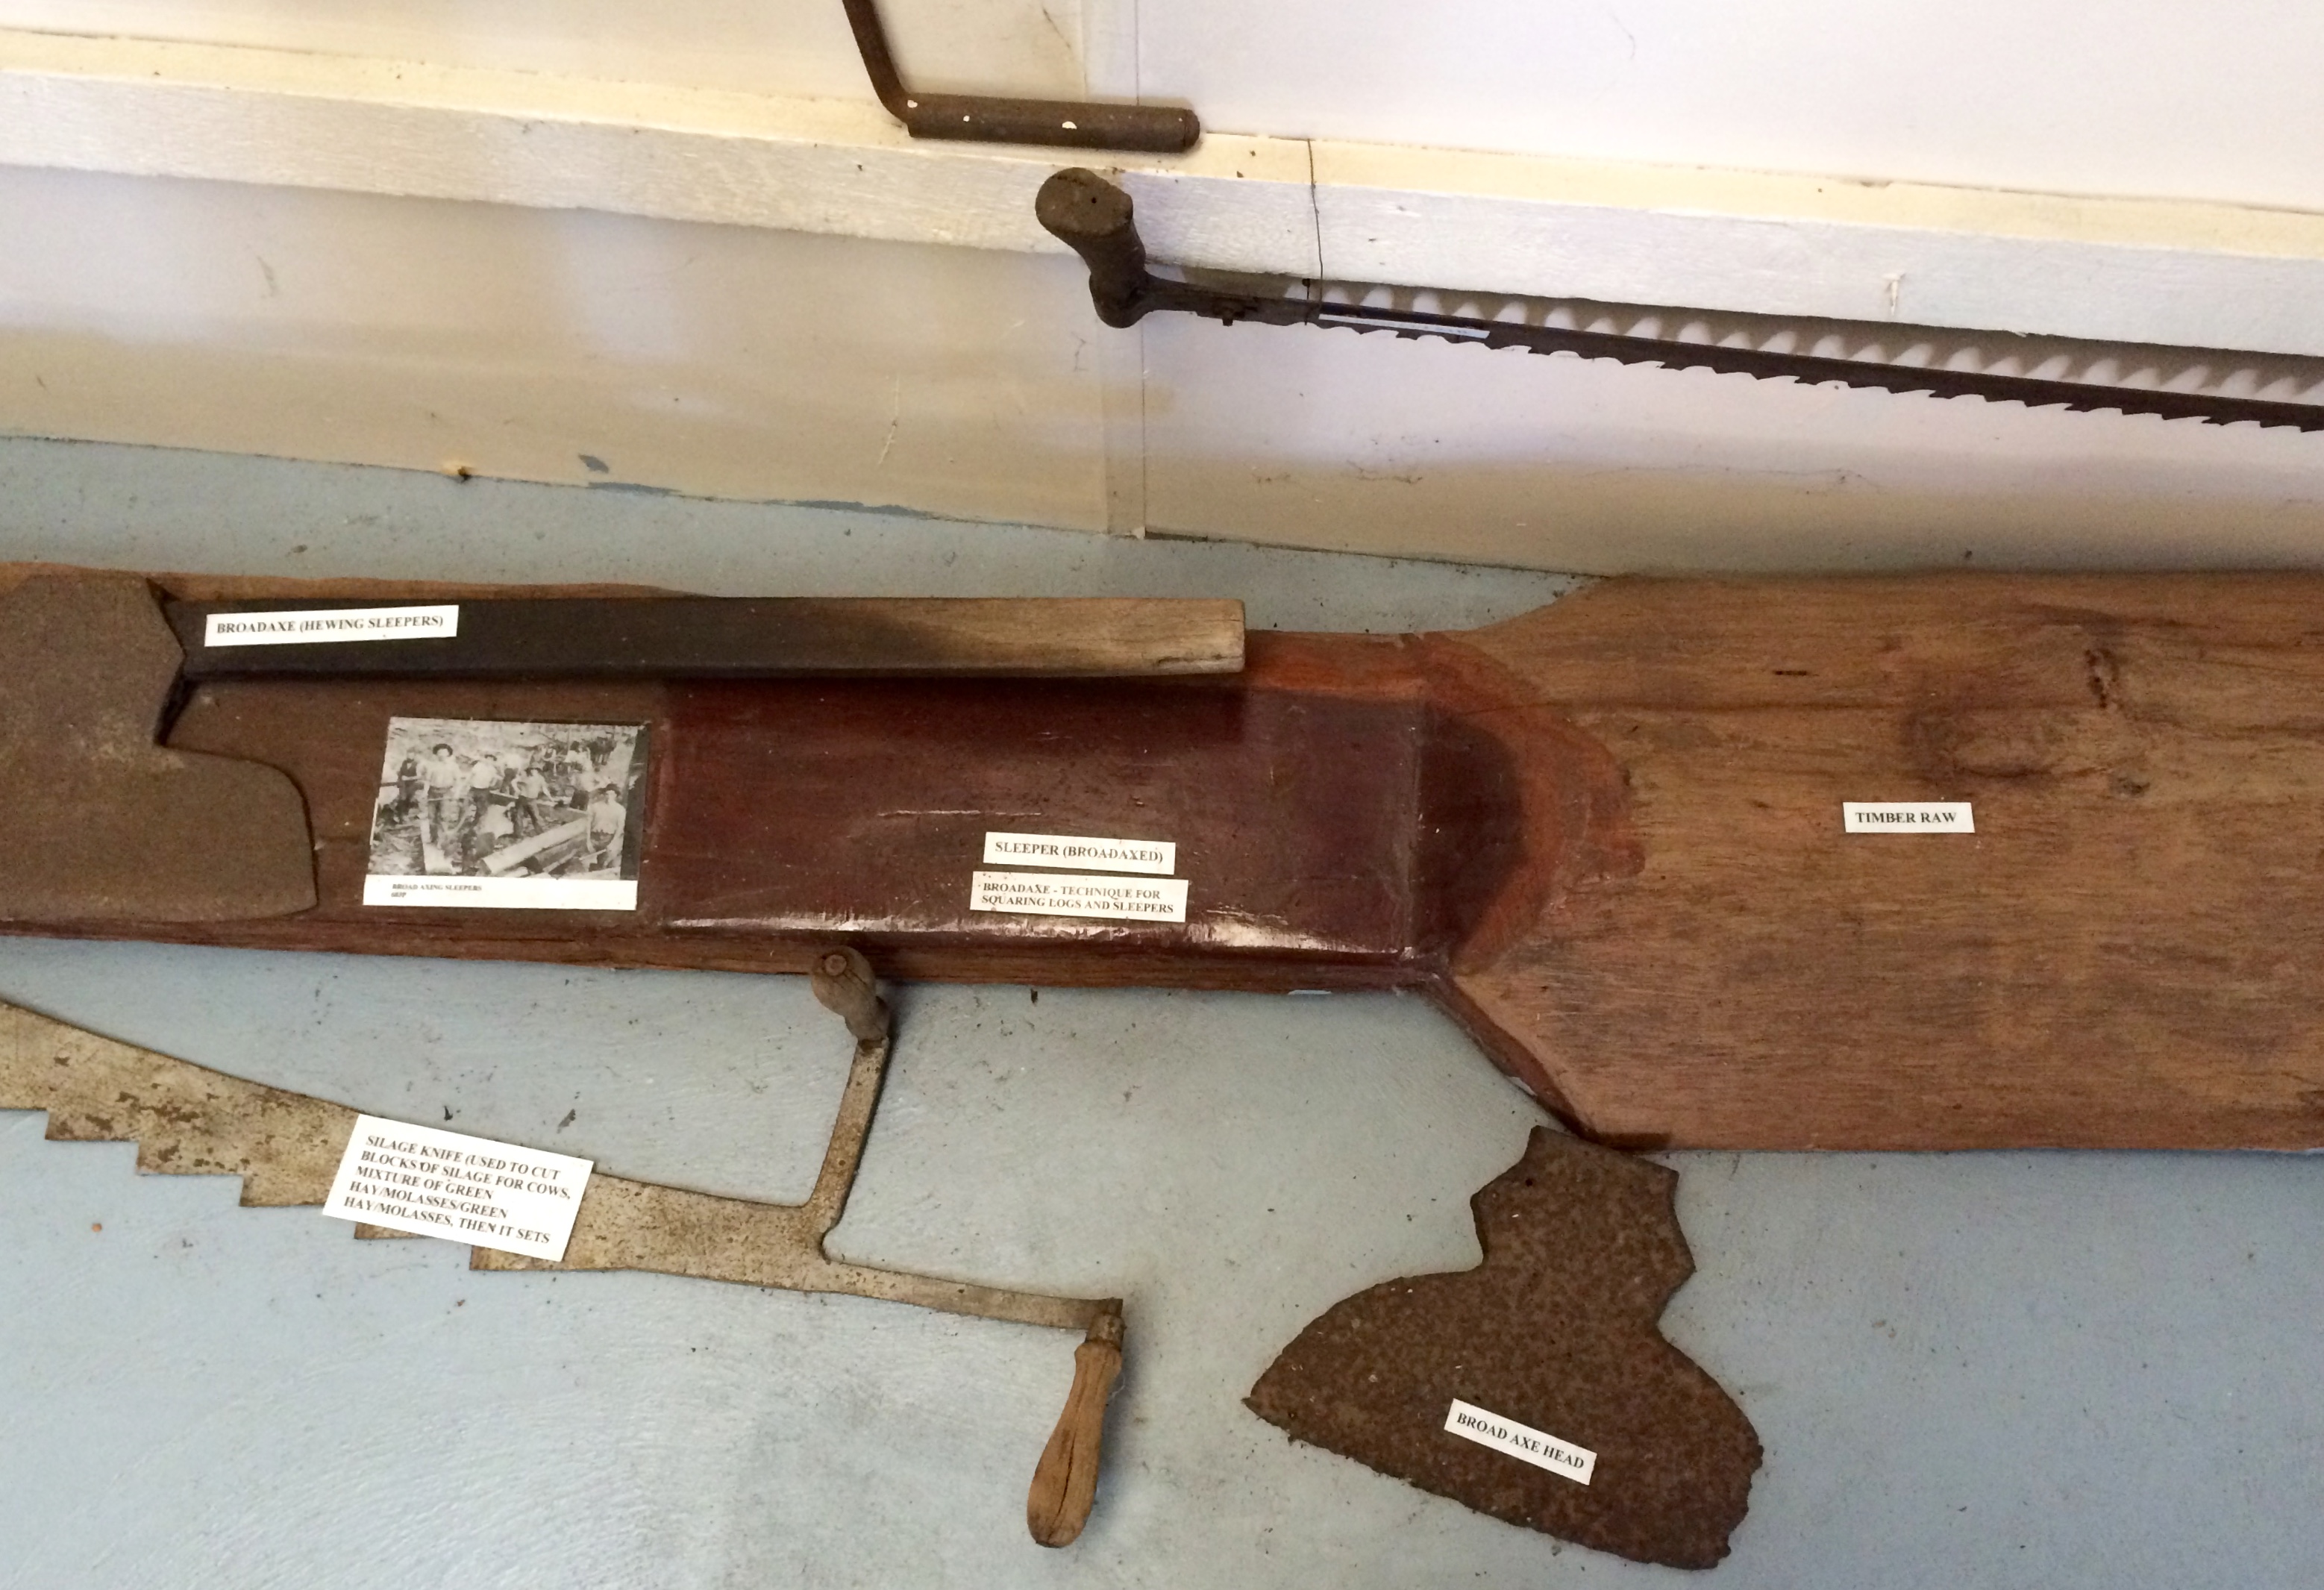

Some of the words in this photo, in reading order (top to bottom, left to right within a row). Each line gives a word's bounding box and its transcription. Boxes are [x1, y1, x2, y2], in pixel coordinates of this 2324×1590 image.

[216, 620, 296, 634] BROADAXE
[299, 619, 364, 633] (HEWING
[368, 616, 444, 629] SLEEPERS)
[1855, 812, 1917, 823] TIMBER
[1921, 812, 1957, 823] RAW
[995, 842, 1059, 856] SLEEPER
[1063, 845, 1164, 864] (BROADAXED)
[981, 895, 1045, 907] SQUARING
[1049, 898, 1082, 909] LOGS
[1084, 900, 1110, 910] AND
[1112, 902, 1174, 913] SLEEPERS
[983, 883, 1050, 895] BROADAXE
[1060, 886, 1133, 900] TECHNIQUE
[1136, 889, 1160, 899] FOR
[360, 1150, 417, 1171] BLOCKS
[420, 1162, 440, 1174] OF
[442, 1165, 492, 1184] SILAGE
[495, 1177, 523, 1190] FOR
[527, 1182, 571, 1201] COWS,
[366, 1135, 418, 1154] SILAGE
[421, 1146, 464, 1163] KNIFE
[465, 1154, 507, 1171] (USED
[510, 1162, 529, 1174] TO
[531, 1166, 561, 1180] CUT
[349, 1180, 509, 1219] HAY/MOLASSES/GREEN
[355, 1165, 421, 1187] MIXTURE
[424, 1179, 442, 1192] OF
[445, 1183, 494, 1201] GREEN
[343, 1196, 454, 1227] HAY/MOLASSES,
[458, 1217, 497, 1233] THEN
[498, 1224, 514, 1236] IT
[516, 1229, 551, 1244] SETS
[1456, 1412, 1508, 1439] BROAD
[1509, 1433, 1541, 1453] AXE
[1543, 1445, 1585, 1469] HEAD
